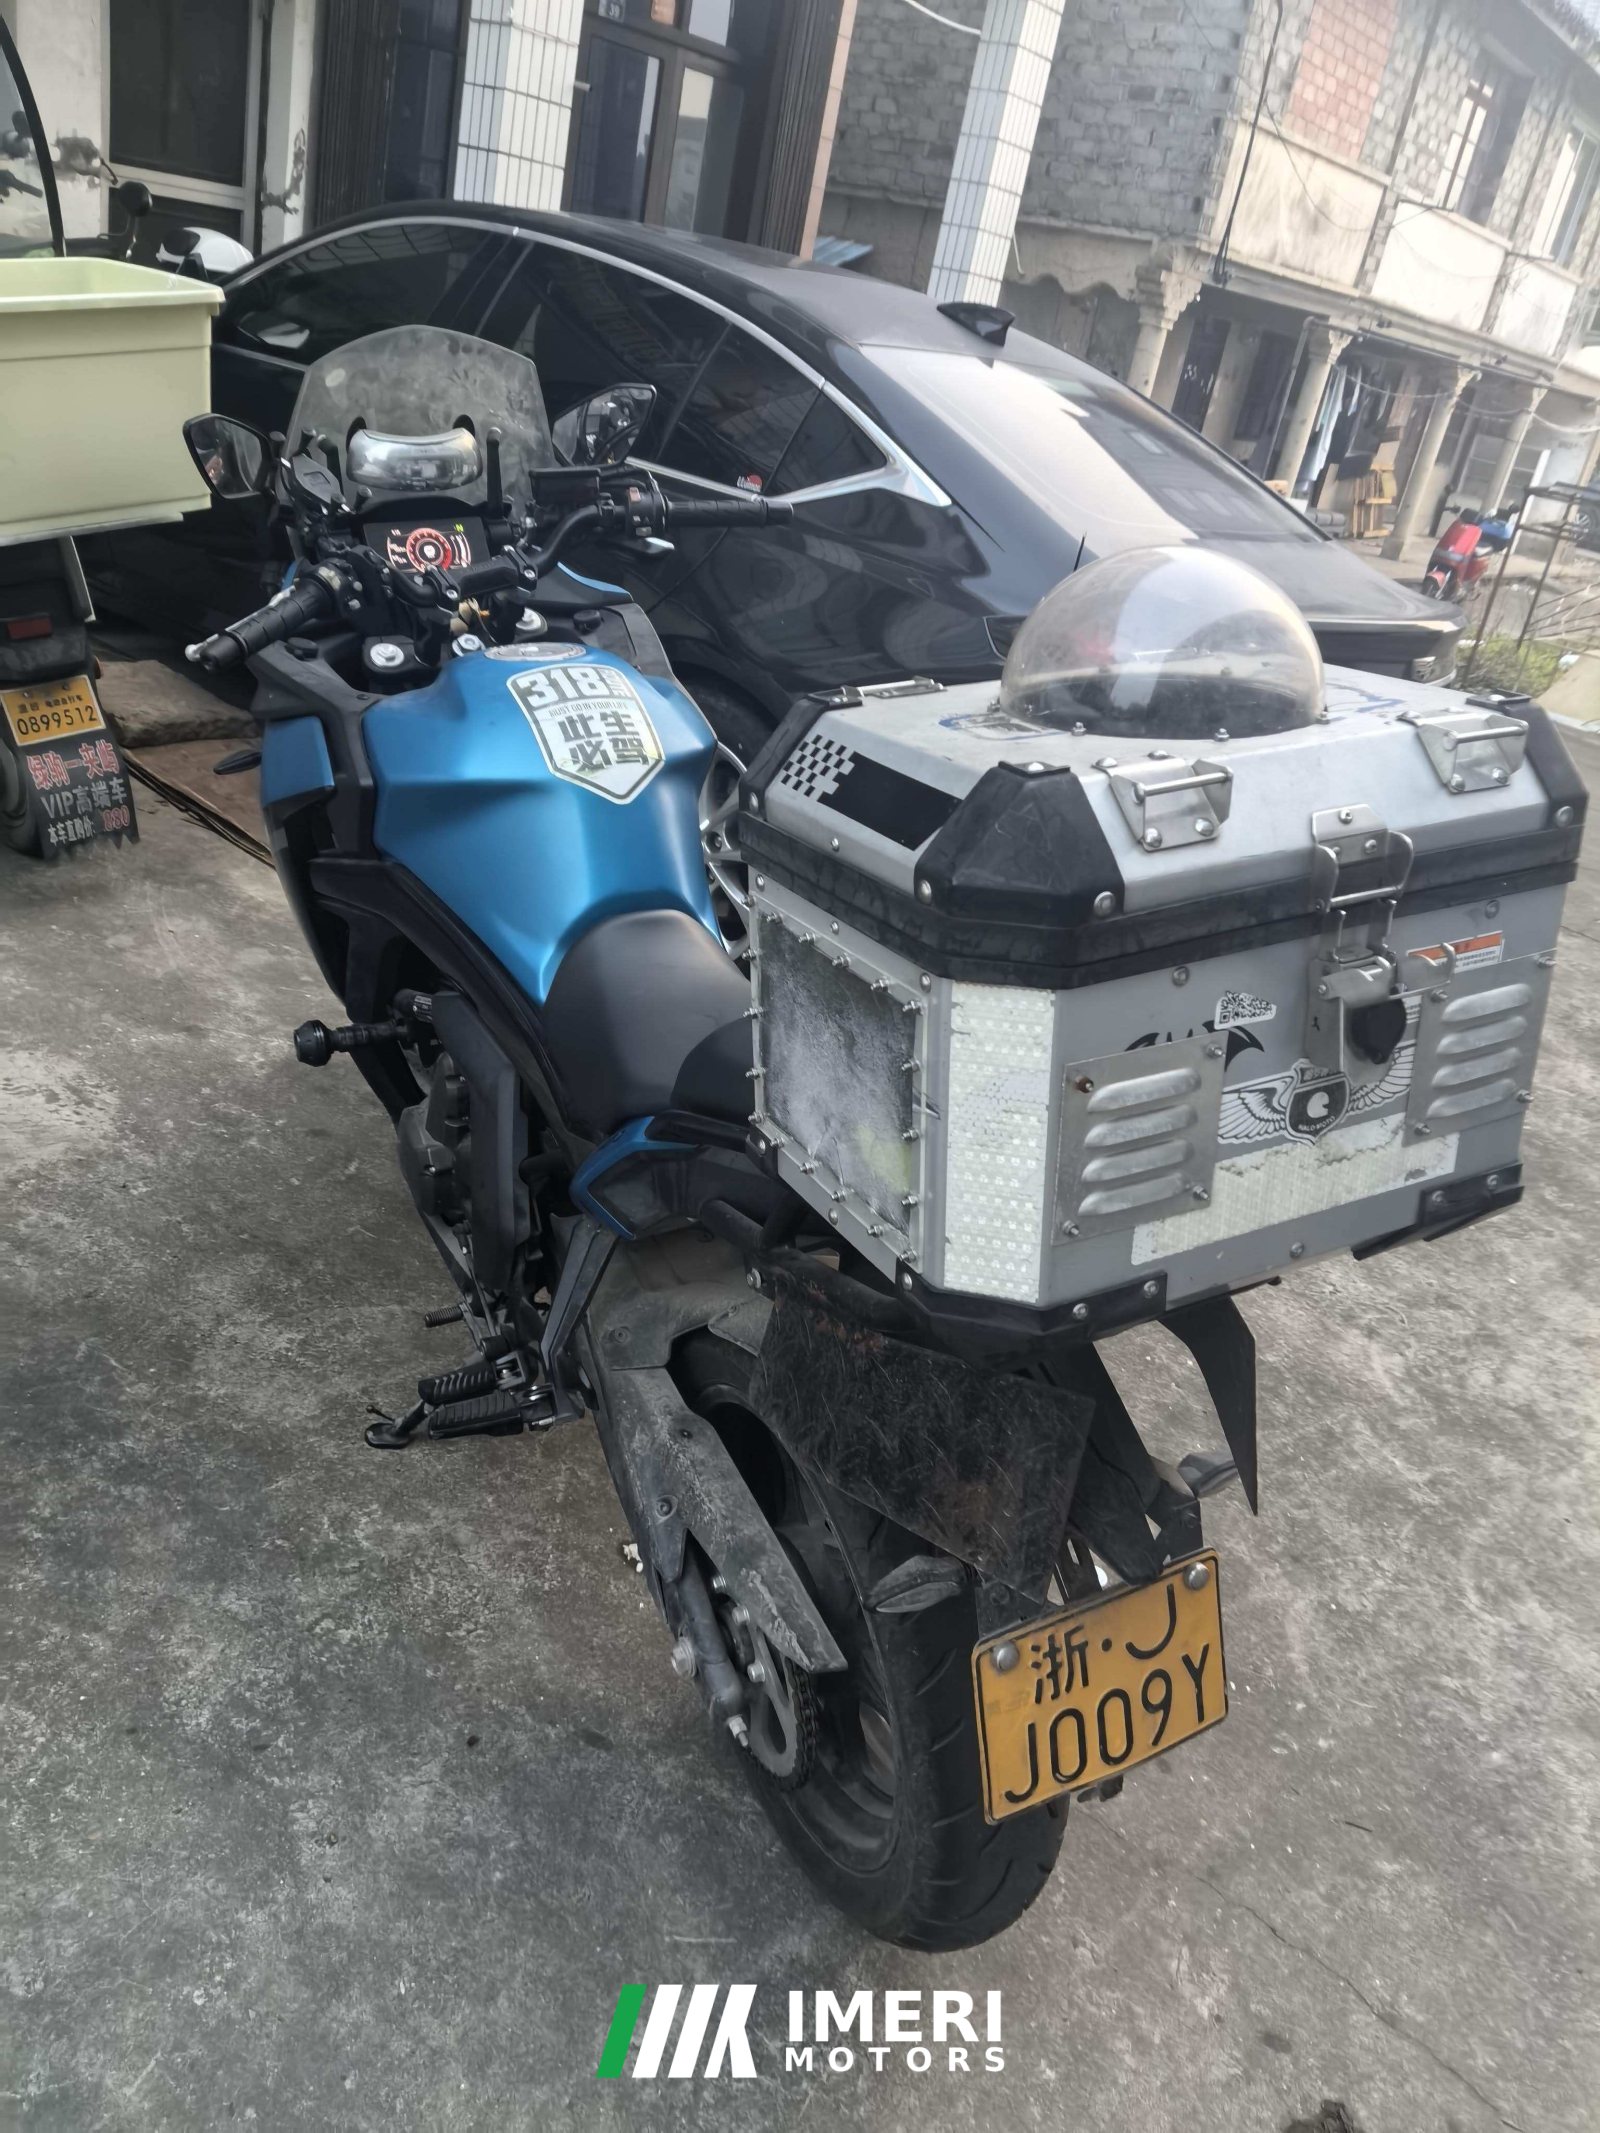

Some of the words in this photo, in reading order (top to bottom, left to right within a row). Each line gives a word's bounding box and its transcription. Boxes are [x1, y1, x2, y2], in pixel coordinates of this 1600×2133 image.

[516, 667, 609, 707] 318
[17, 705, 97, 735] 0899512
[571, 703, 583, 711] GO
[558, 710, 640, 743] 此生
[569, 737, 650, 773] 必驾
[42, 778, 127, 818] VIP高端车
[1031, 1583, 1177, 1704] 浙·J
[1004, 1643, 1210, 1803] J009Y
